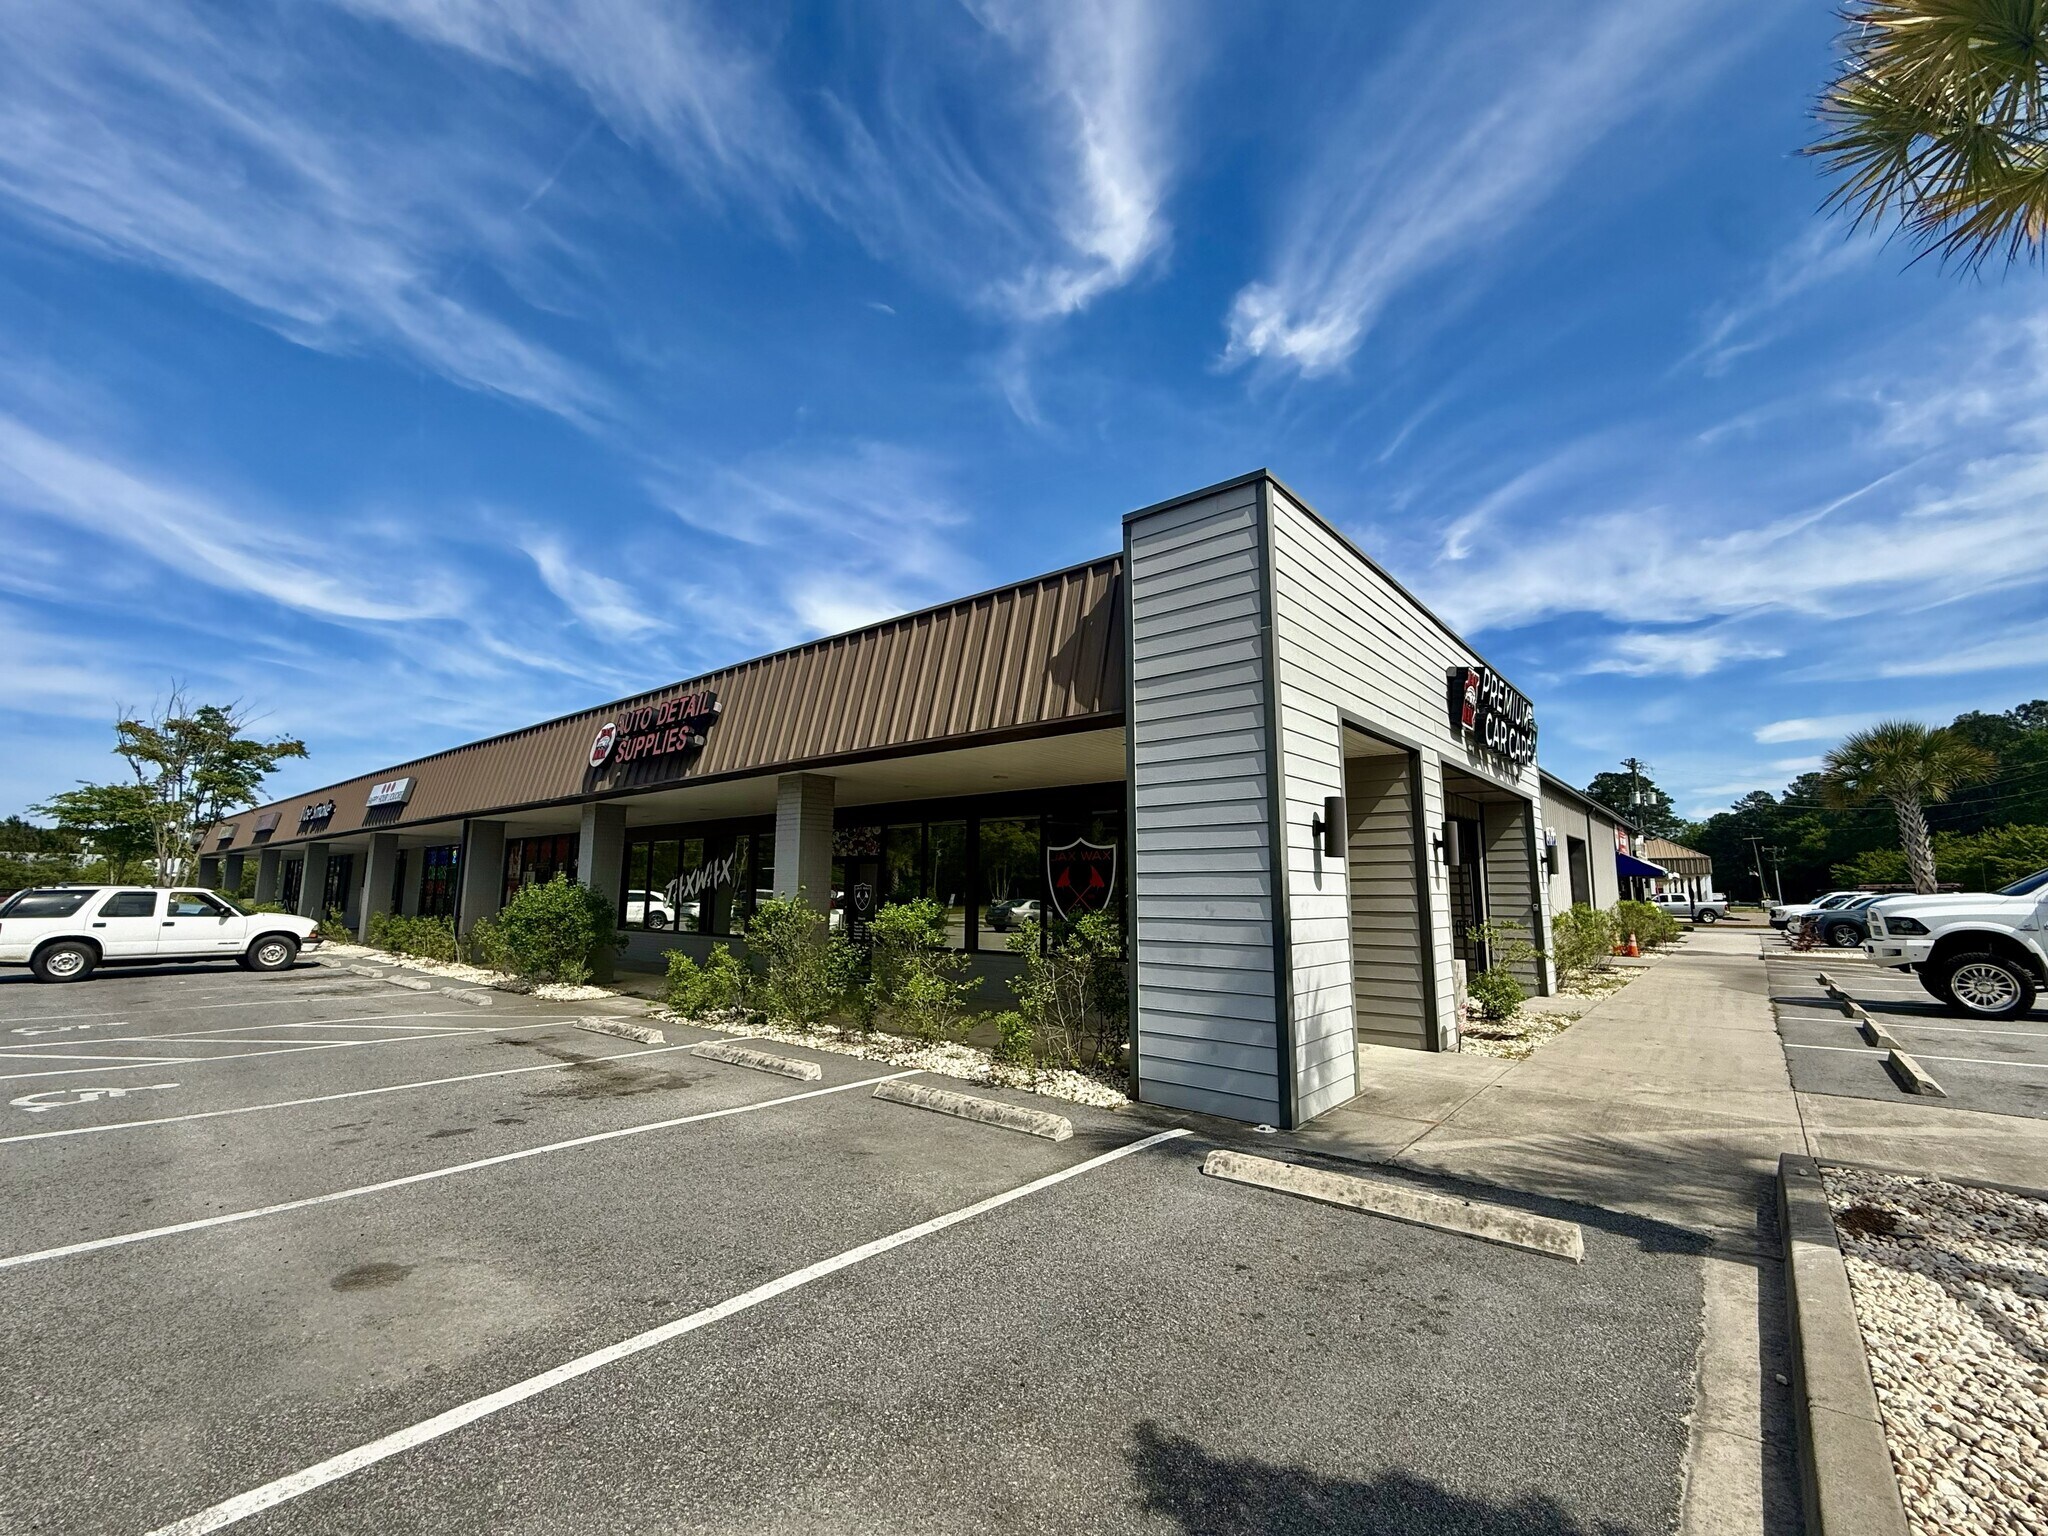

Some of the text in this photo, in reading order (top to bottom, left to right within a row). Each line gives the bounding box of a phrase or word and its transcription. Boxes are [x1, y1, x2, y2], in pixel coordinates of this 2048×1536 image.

[616, 691, 710, 735] AUTO DETAIL
[1481, 667, 1533, 731] PREMIUM
[615, 726, 690, 764] SUPPLIES
[1485, 713, 1507, 754] CAR
[1508, 728, 1533, 767] CARE
[1051, 850, 1111, 861] JAX WAX
